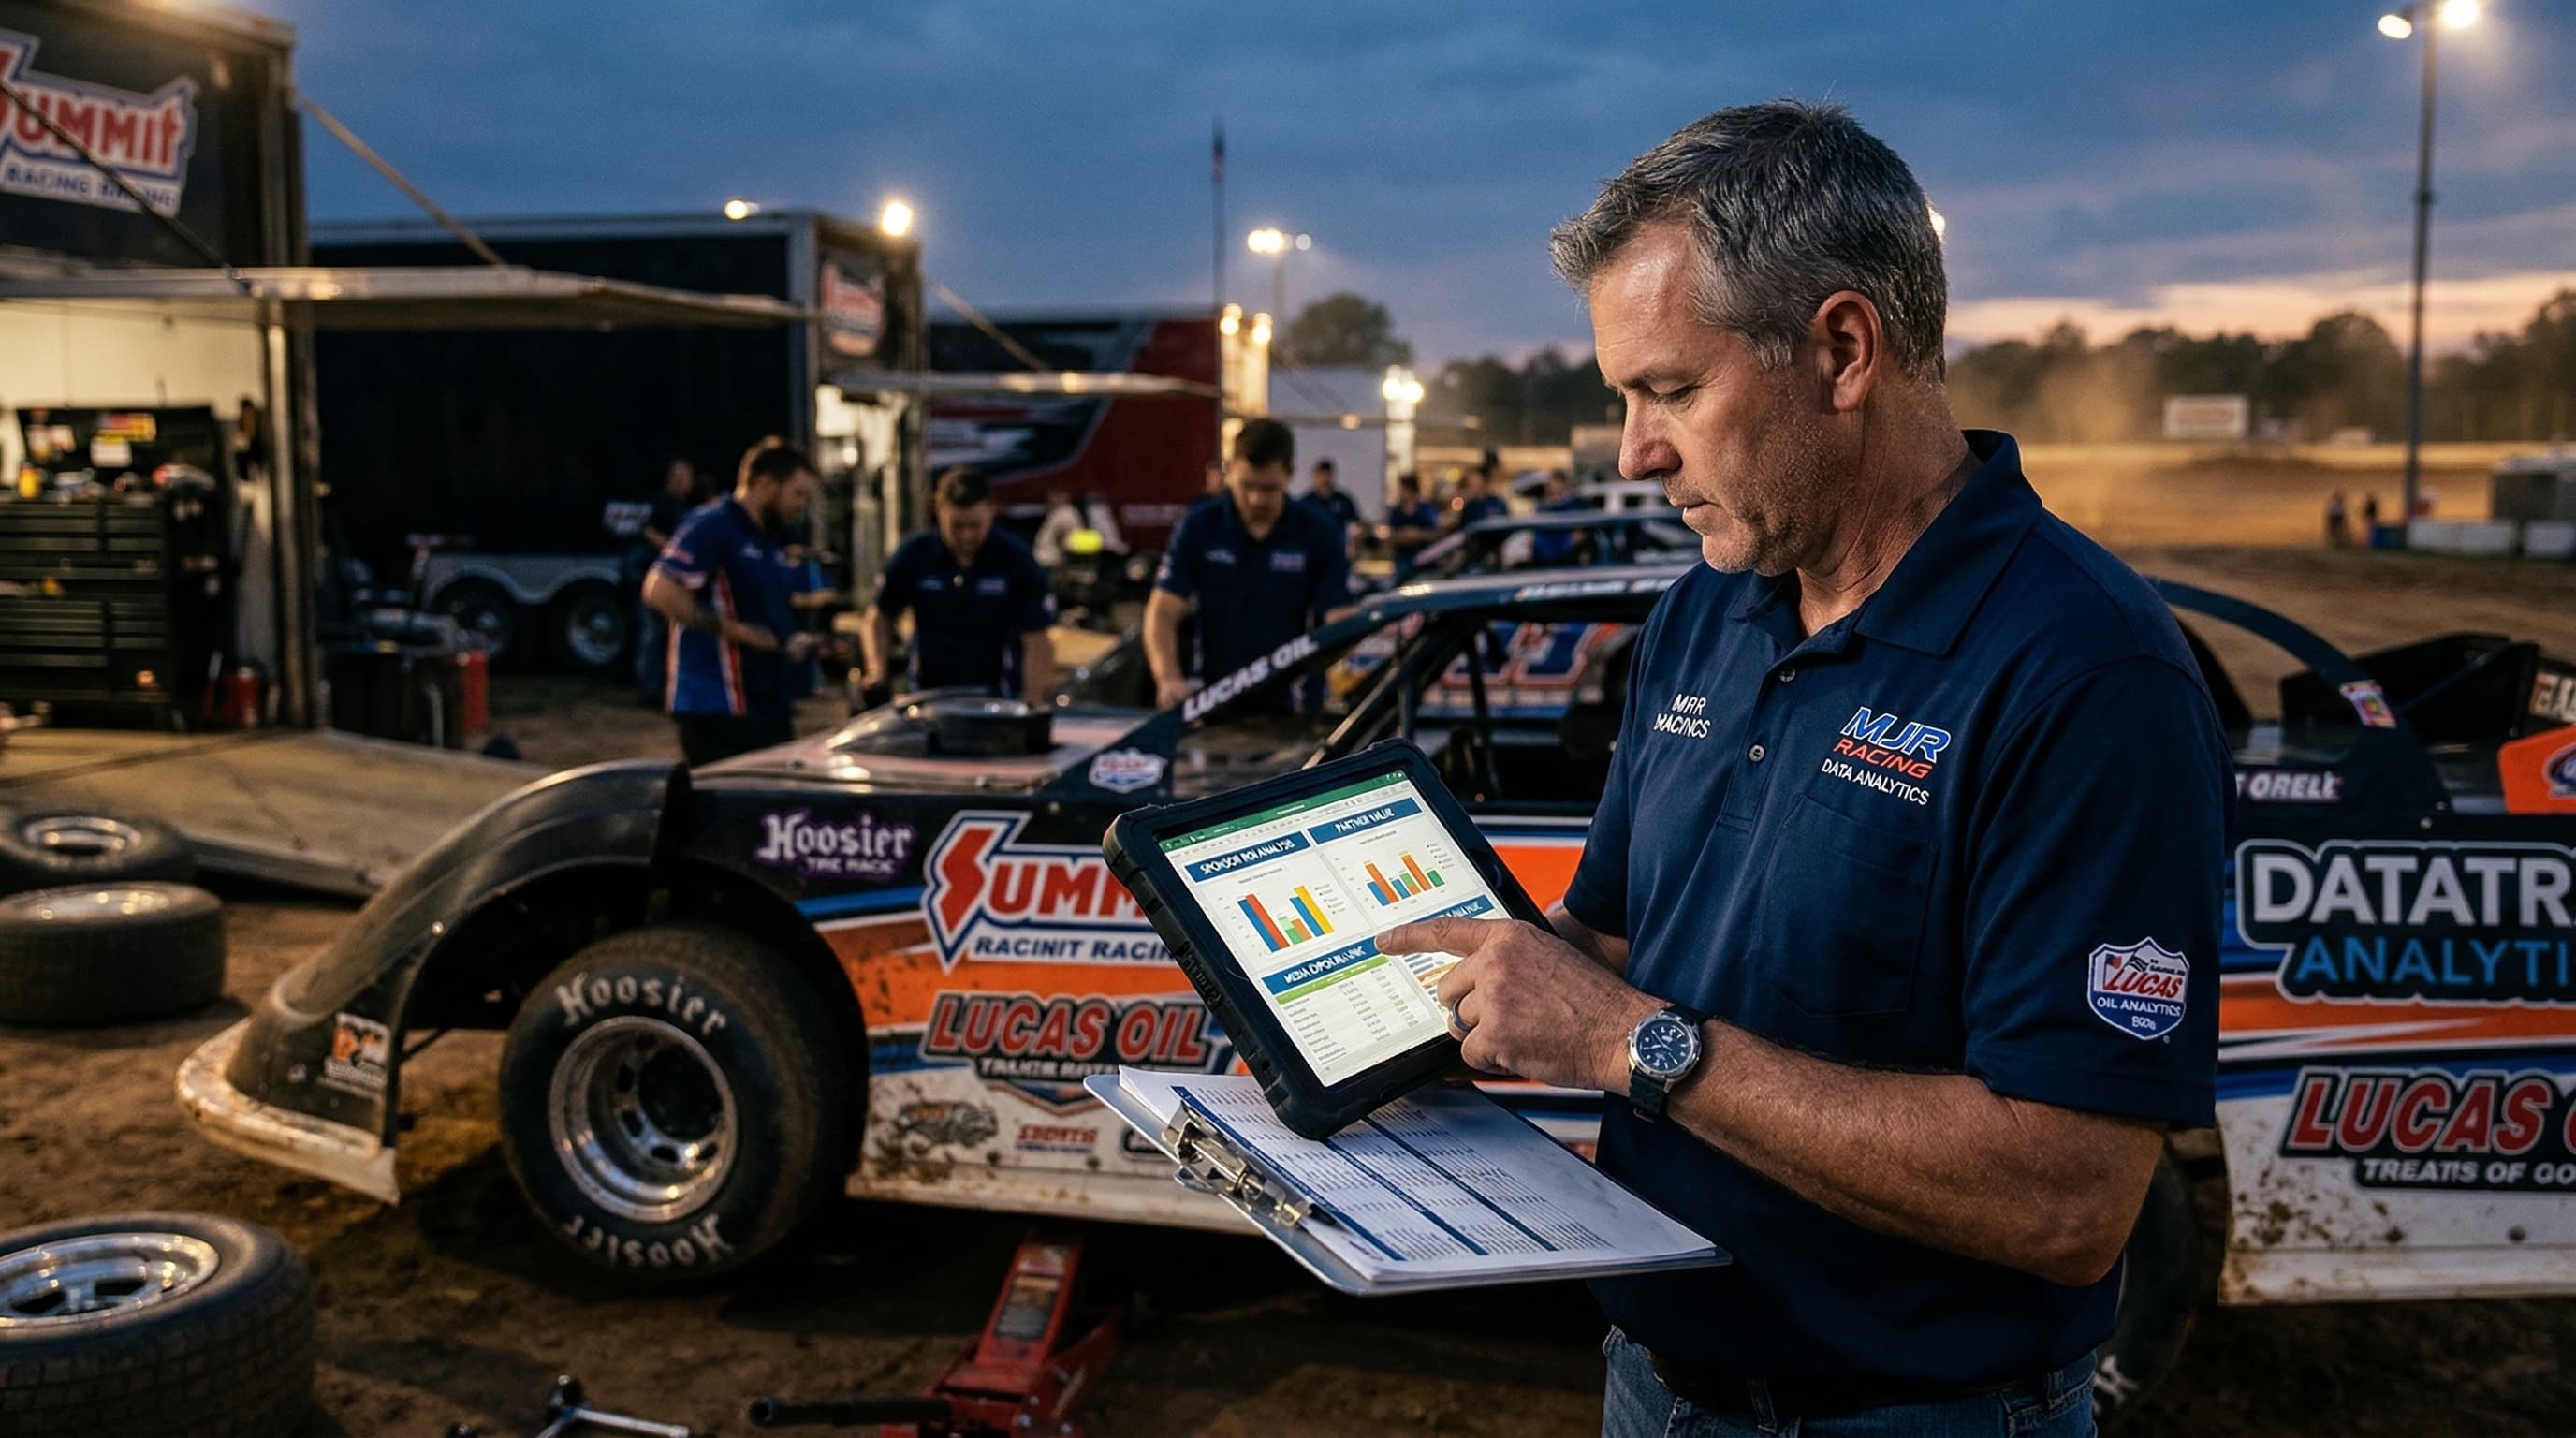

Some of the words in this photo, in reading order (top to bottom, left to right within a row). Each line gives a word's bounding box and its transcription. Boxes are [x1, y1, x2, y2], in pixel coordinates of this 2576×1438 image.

[1183, 655, 1269, 723] LUCAS
[1270, 634, 1320, 669] OIL
[1833, 738, 1933, 779] RACING
[1839, 706, 1951, 764] MJR
[1821, 758, 1852, 781] DATA
[1852, 770, 1930, 805] ANALYTICS
[756, 813, 913, 861] Hoosier
[939, 827, 1146, 934] SUMM
[2252, 853, 2576, 927] DATATR
[1090, 940, 1178, 961] RACIN
[2295, 935, 2570, 987] ANALYTI
[554, 971, 727, 1034] Hoosier
[2097, 996, 2117, 1009] OIL
[2119, 999, 2181, 1017] ANALYTICS
[2102, 968, 2183, 999] LUCAS
[928, 998, 1110, 1059] LUCAS
[1116, 1004, 1205, 1064] OIL
[2286, 1077, 2553, 1155] LUCAS
[2485, 1162, 2527, 1184] OF
